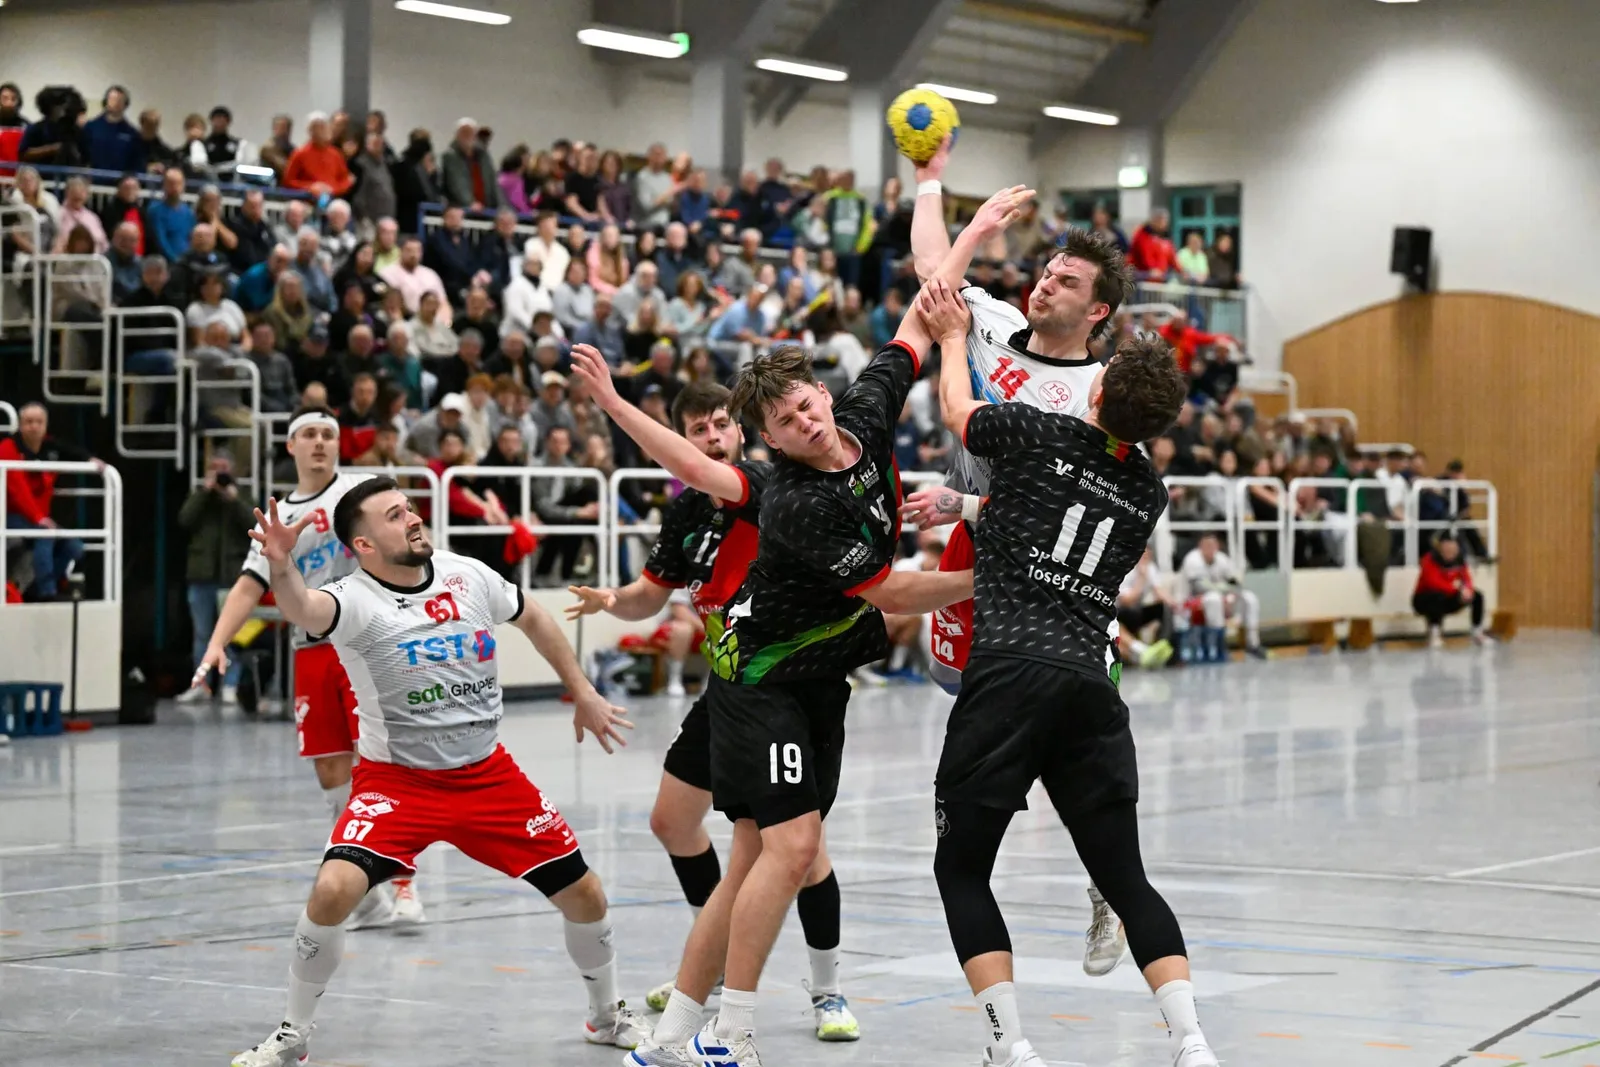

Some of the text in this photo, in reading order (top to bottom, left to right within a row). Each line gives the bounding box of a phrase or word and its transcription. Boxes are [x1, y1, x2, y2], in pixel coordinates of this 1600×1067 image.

[989, 356, 1031, 400] 14
[1049, 384, 1069, 402] TGO
[1082, 468, 1120, 493] VR Bank
[1078, 478, 1150, 521] Rhein-Neckar eG
[1051, 502, 1115, 577] 11
[445, 576, 463, 590] TGO
[424, 592, 460, 624] 67
[397, 632, 468, 665] TST
[933, 634, 955, 662] 14
[407, 682, 444, 705] sat
[769, 743, 802, 784] 19
[342, 819, 375, 842] 67
[985, 1003, 1000, 1029] CRAFT
